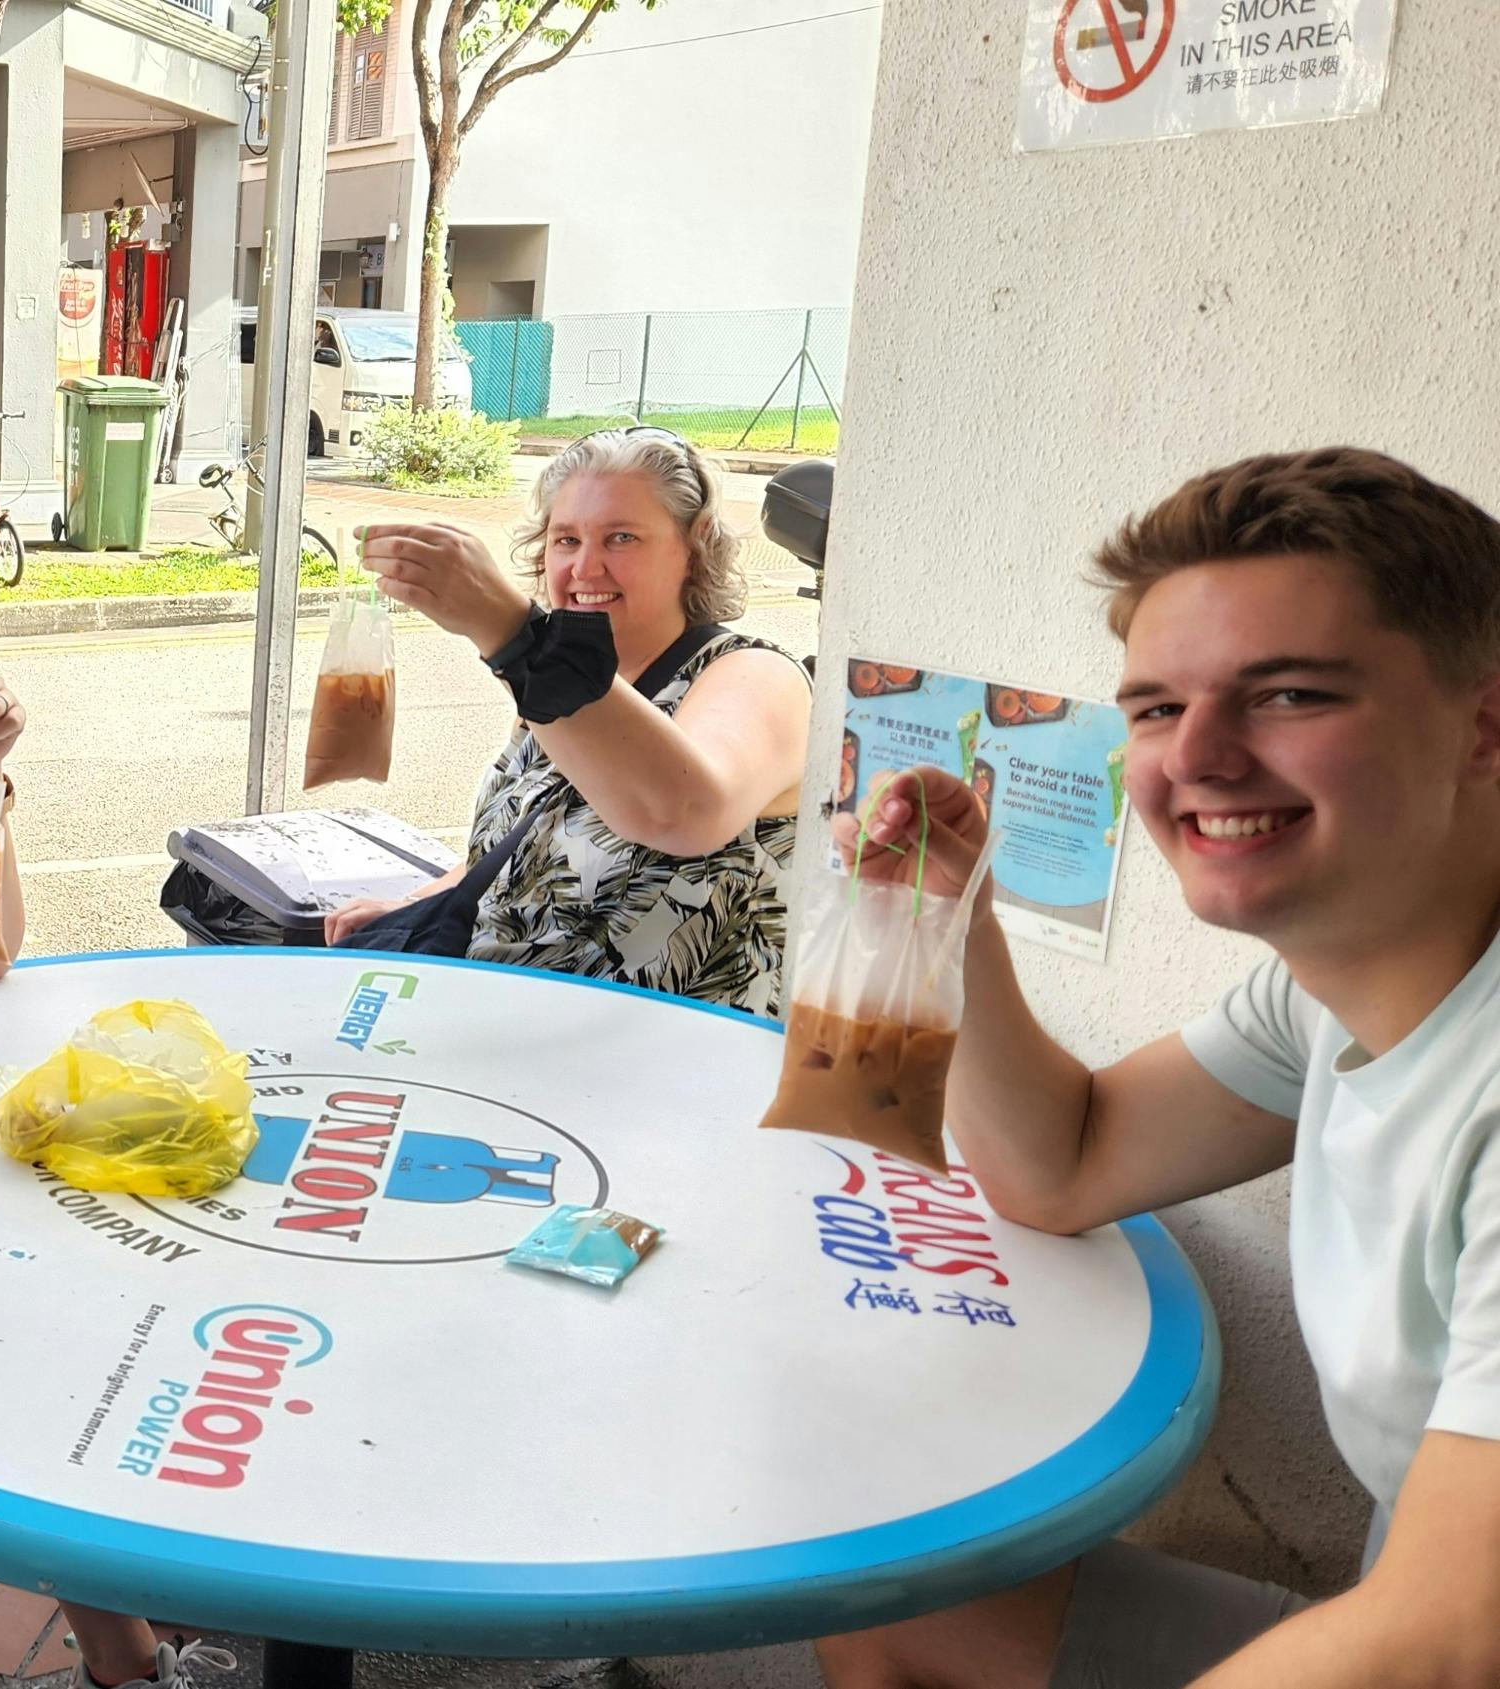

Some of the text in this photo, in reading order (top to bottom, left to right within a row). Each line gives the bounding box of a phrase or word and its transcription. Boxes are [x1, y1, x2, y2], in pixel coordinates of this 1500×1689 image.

[1220, 0, 1317, 25] SMOKE
[1180, 20, 1352, 67] IN THIS AREA
[1186, 55, 1340, 95] 请不要在此处吸烟
[1009, 757, 1104, 788] Clear your table
[1010, 772, 1098, 801] to avoid a fine.
[1006, 787, 1049, 805] Bersihkan
[1073, 805, 1097, 817] anda
[273, 1090, 407, 1243] UNION
[48, 1186, 202, 1263] COMPANY
[133, 1304, 165, 1339] Energy
[128, 1338, 148, 1354] for
[100, 1362, 135, 1406] brighter
[157, 1318, 314, 1489] union
[67, 1407, 110, 1466] tomorrow!
[117, 1378, 190, 1477] POWER
